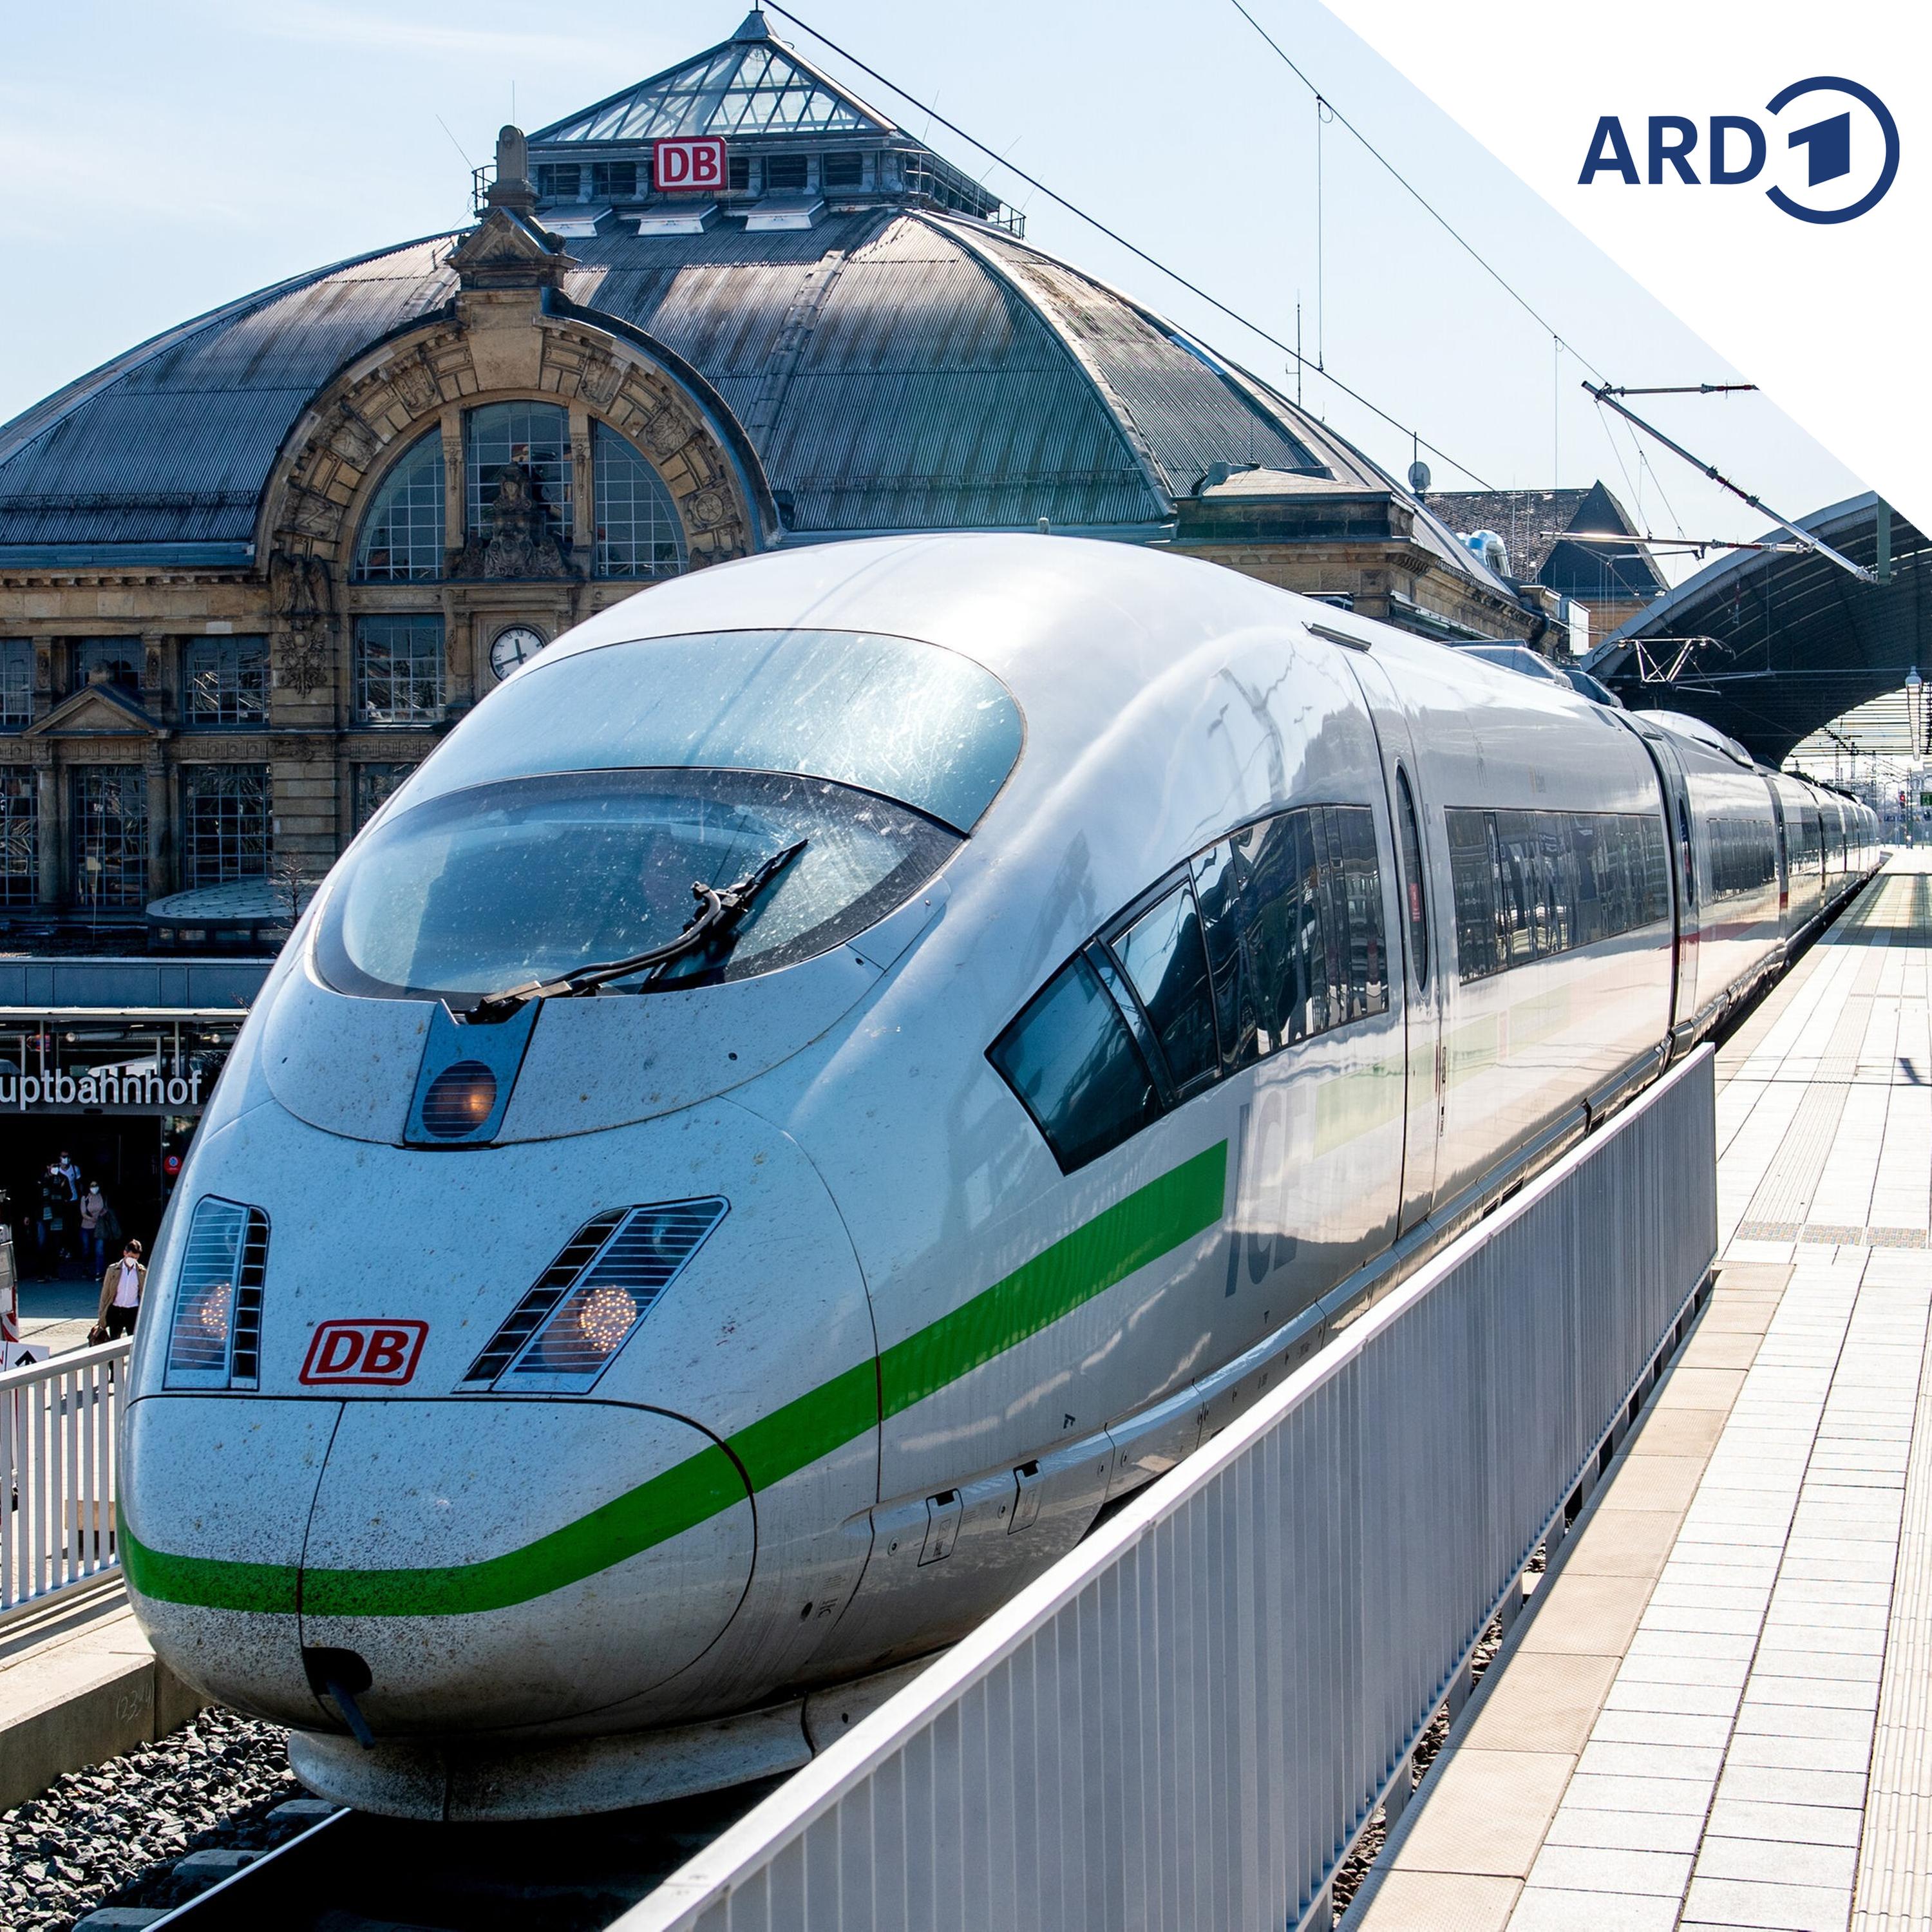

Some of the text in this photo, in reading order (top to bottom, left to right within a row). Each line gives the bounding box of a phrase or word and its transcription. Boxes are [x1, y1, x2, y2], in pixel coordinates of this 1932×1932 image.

[663, 146, 718, 182] DB
[0, 1068, 202, 1110] uptbahnhof
[316, 1330, 409, 1374] DB
